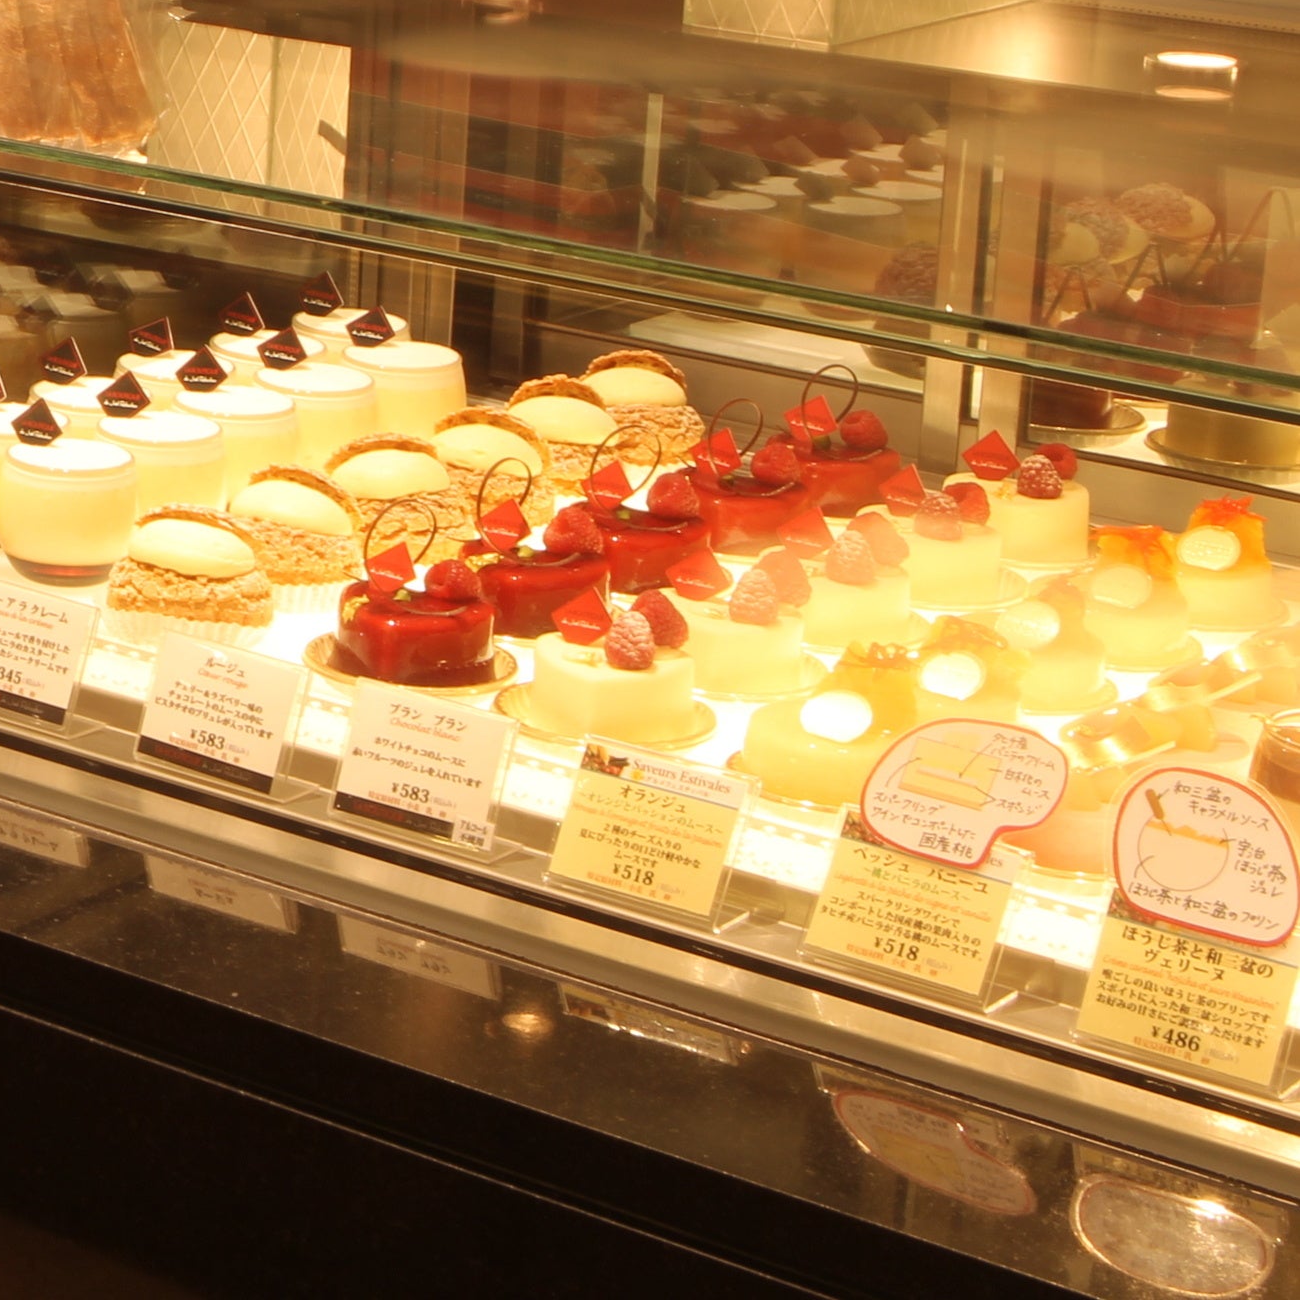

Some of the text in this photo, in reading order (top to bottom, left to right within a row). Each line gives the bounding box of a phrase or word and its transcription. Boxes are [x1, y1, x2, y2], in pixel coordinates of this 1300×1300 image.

[31, 604, 68, 623] クレーム
[205, 657, 246, 678] ルージュ
[390, 703, 468, 732] ブラン ブラン
[190, 728, 226, 750] ¥583
[375, 737, 466, 768] ホワイトチョコのムースに
[632, 758, 678, 782] Saveurs
[391, 782, 430, 804] ¥583
[620, 785, 687, 814] オランジュ
[614, 849, 658, 869] ムースです
[853, 847, 990, 894] ペッシュ バニーユ
[613, 863, 655, 886] ¥518
[874, 936, 920, 962] ¥518
[1122, 925, 1274, 979] ほうじ茶と和三盆の
[1144, 950, 1225, 981] ヴェリーヌ
[1096, 994, 1266, 1049] お好みの甘さにご調整ただけます
[1151, 1025, 1201, 1052] ¥486
